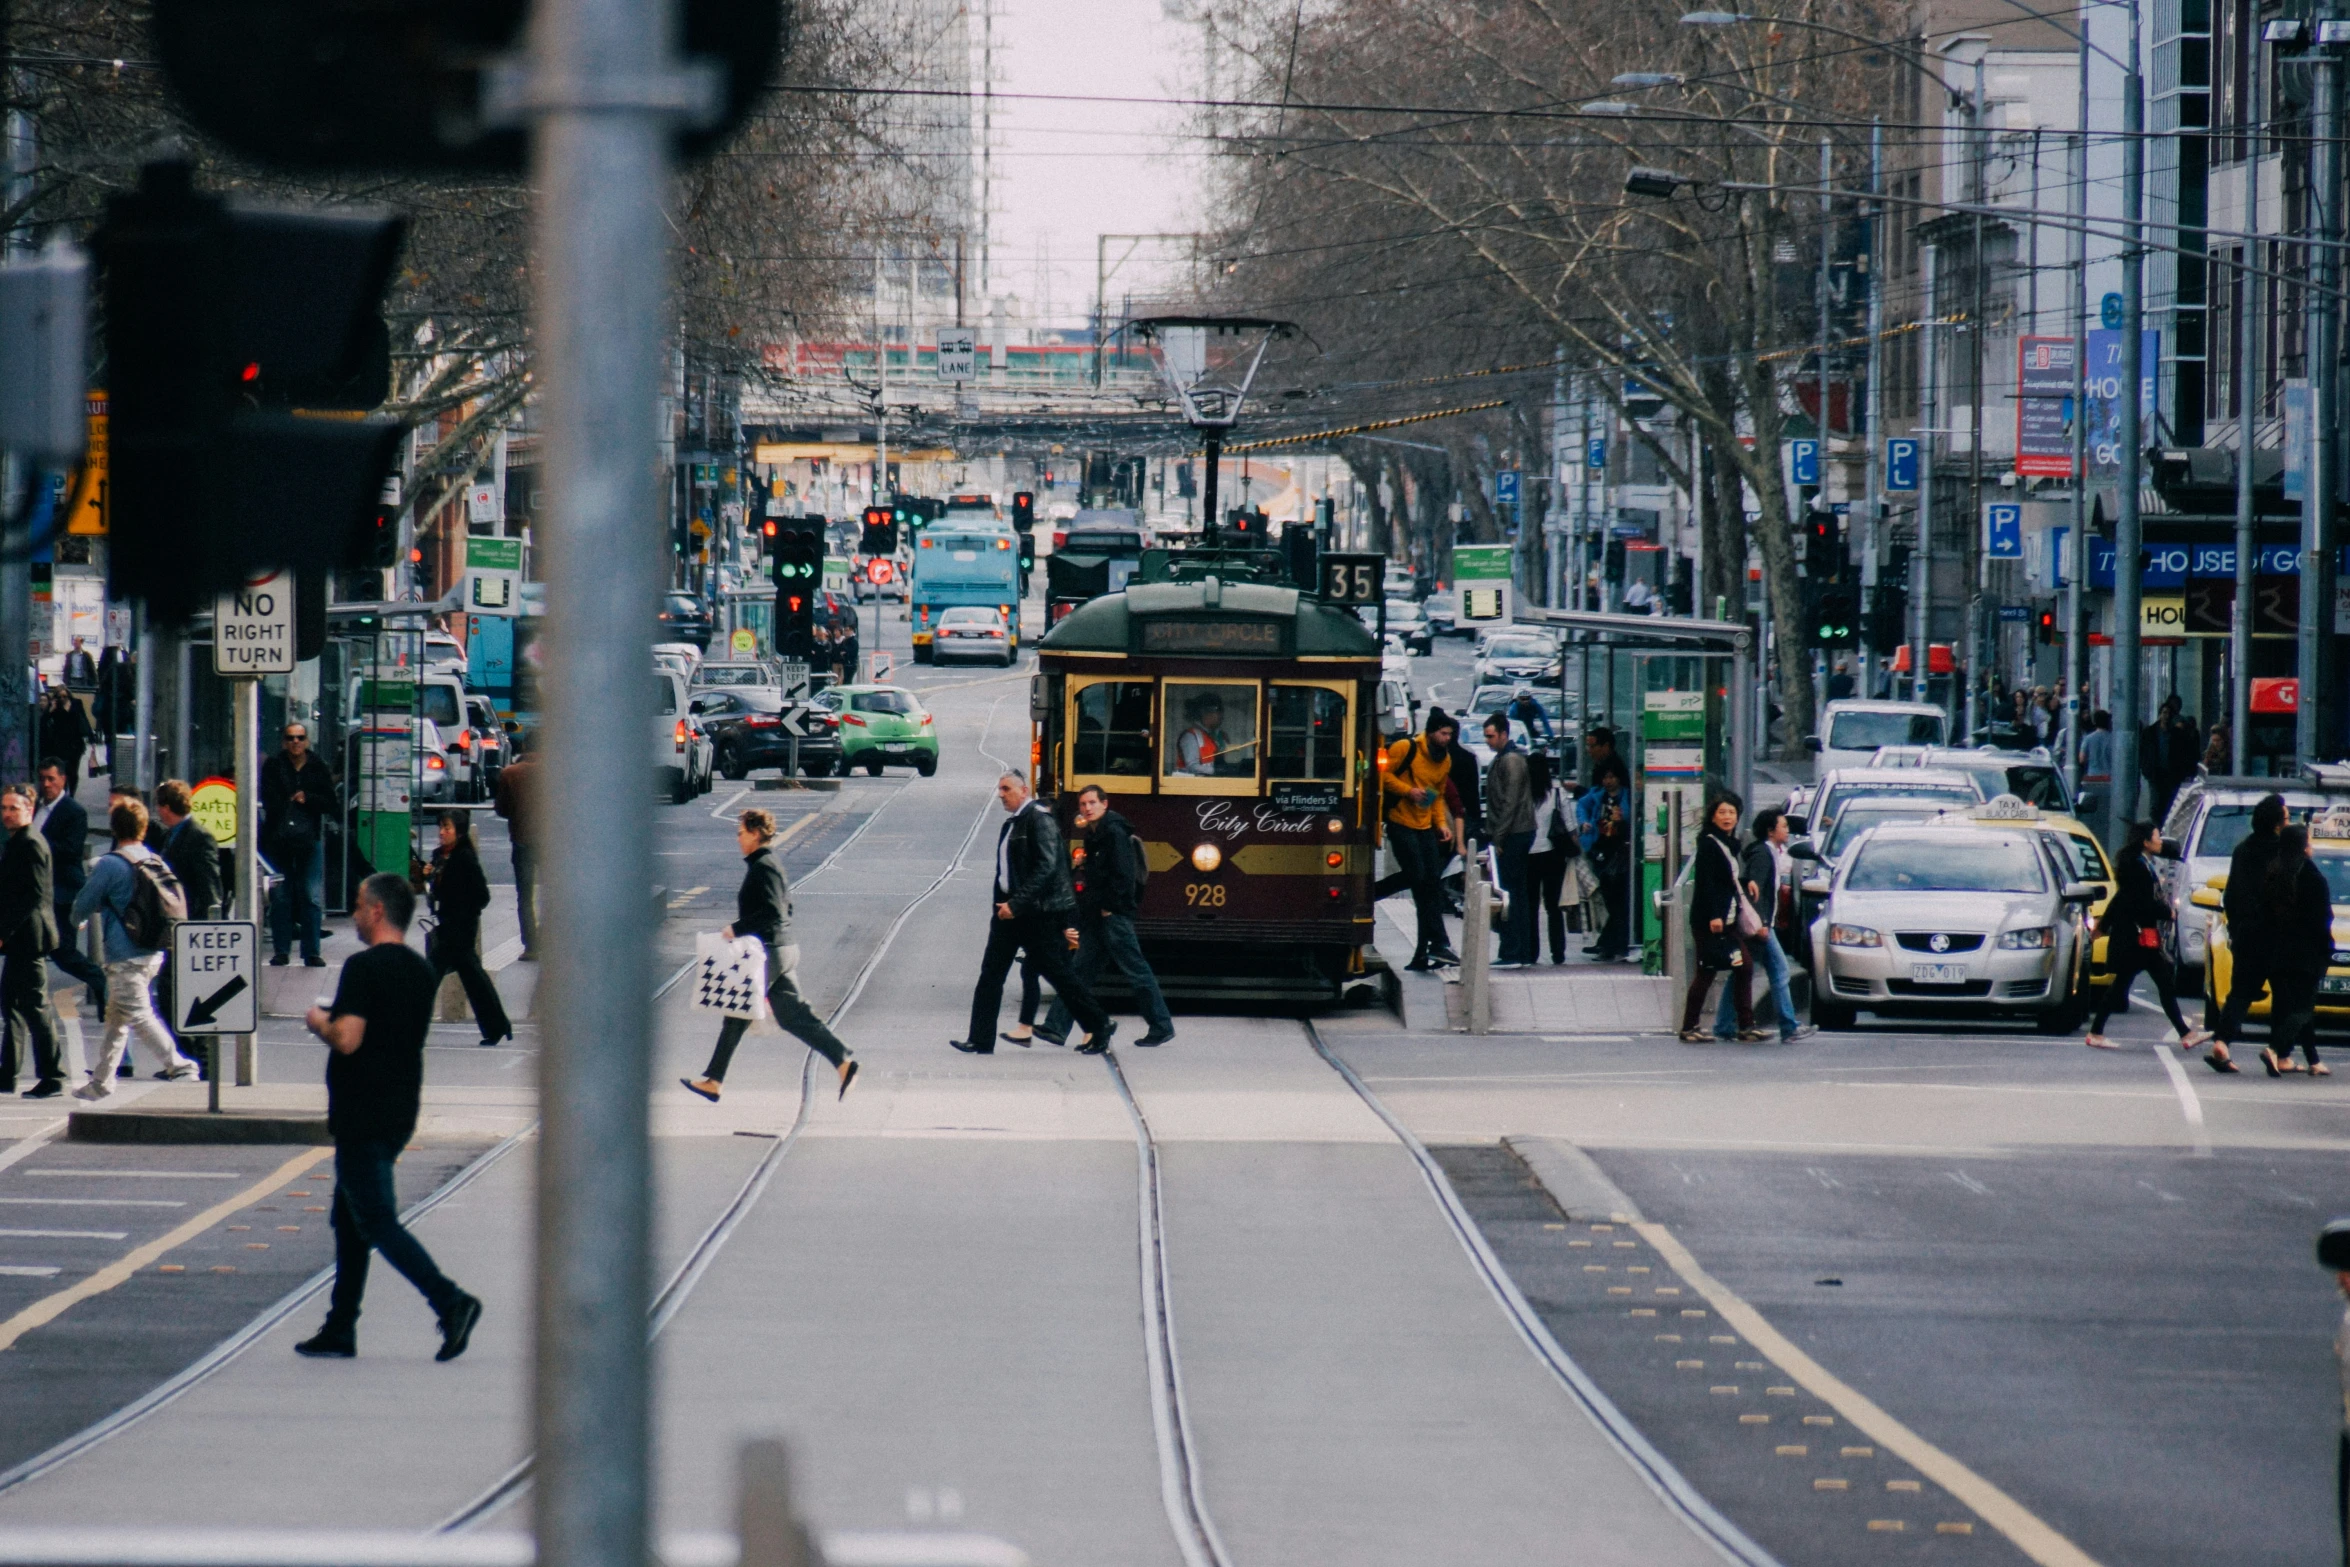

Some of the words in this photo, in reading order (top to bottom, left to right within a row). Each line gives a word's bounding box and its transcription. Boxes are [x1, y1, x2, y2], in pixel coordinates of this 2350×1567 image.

[941, 362, 971, 374] LANE
[2089, 376, 2153, 399] HOE
[1894, 443, 1912, 465] P
[1996, 508, 2016, 533] P
[1330, 564, 1371, 598] 35
[234, 594, 274, 616] NO
[225, 625, 285, 640] RIGHT
[1153, 623, 1197, 639] CITY
[1207, 623, 1275, 642] CIRCLE
[227, 648, 282, 663] TURN
[1291, 795, 1326, 805] Flinders
[1328, 796, 1338, 805] St
[1998, 801, 2020, 809] TAXI
[1196, 801, 1250, 840] City
[1253, 803, 1316, 832] Circle
[2313, 828, 2343, 837] Black
[1185, 884, 1226, 907] 928
[189, 932, 242, 949] KEEP
[191, 955, 240, 972] LEFT
